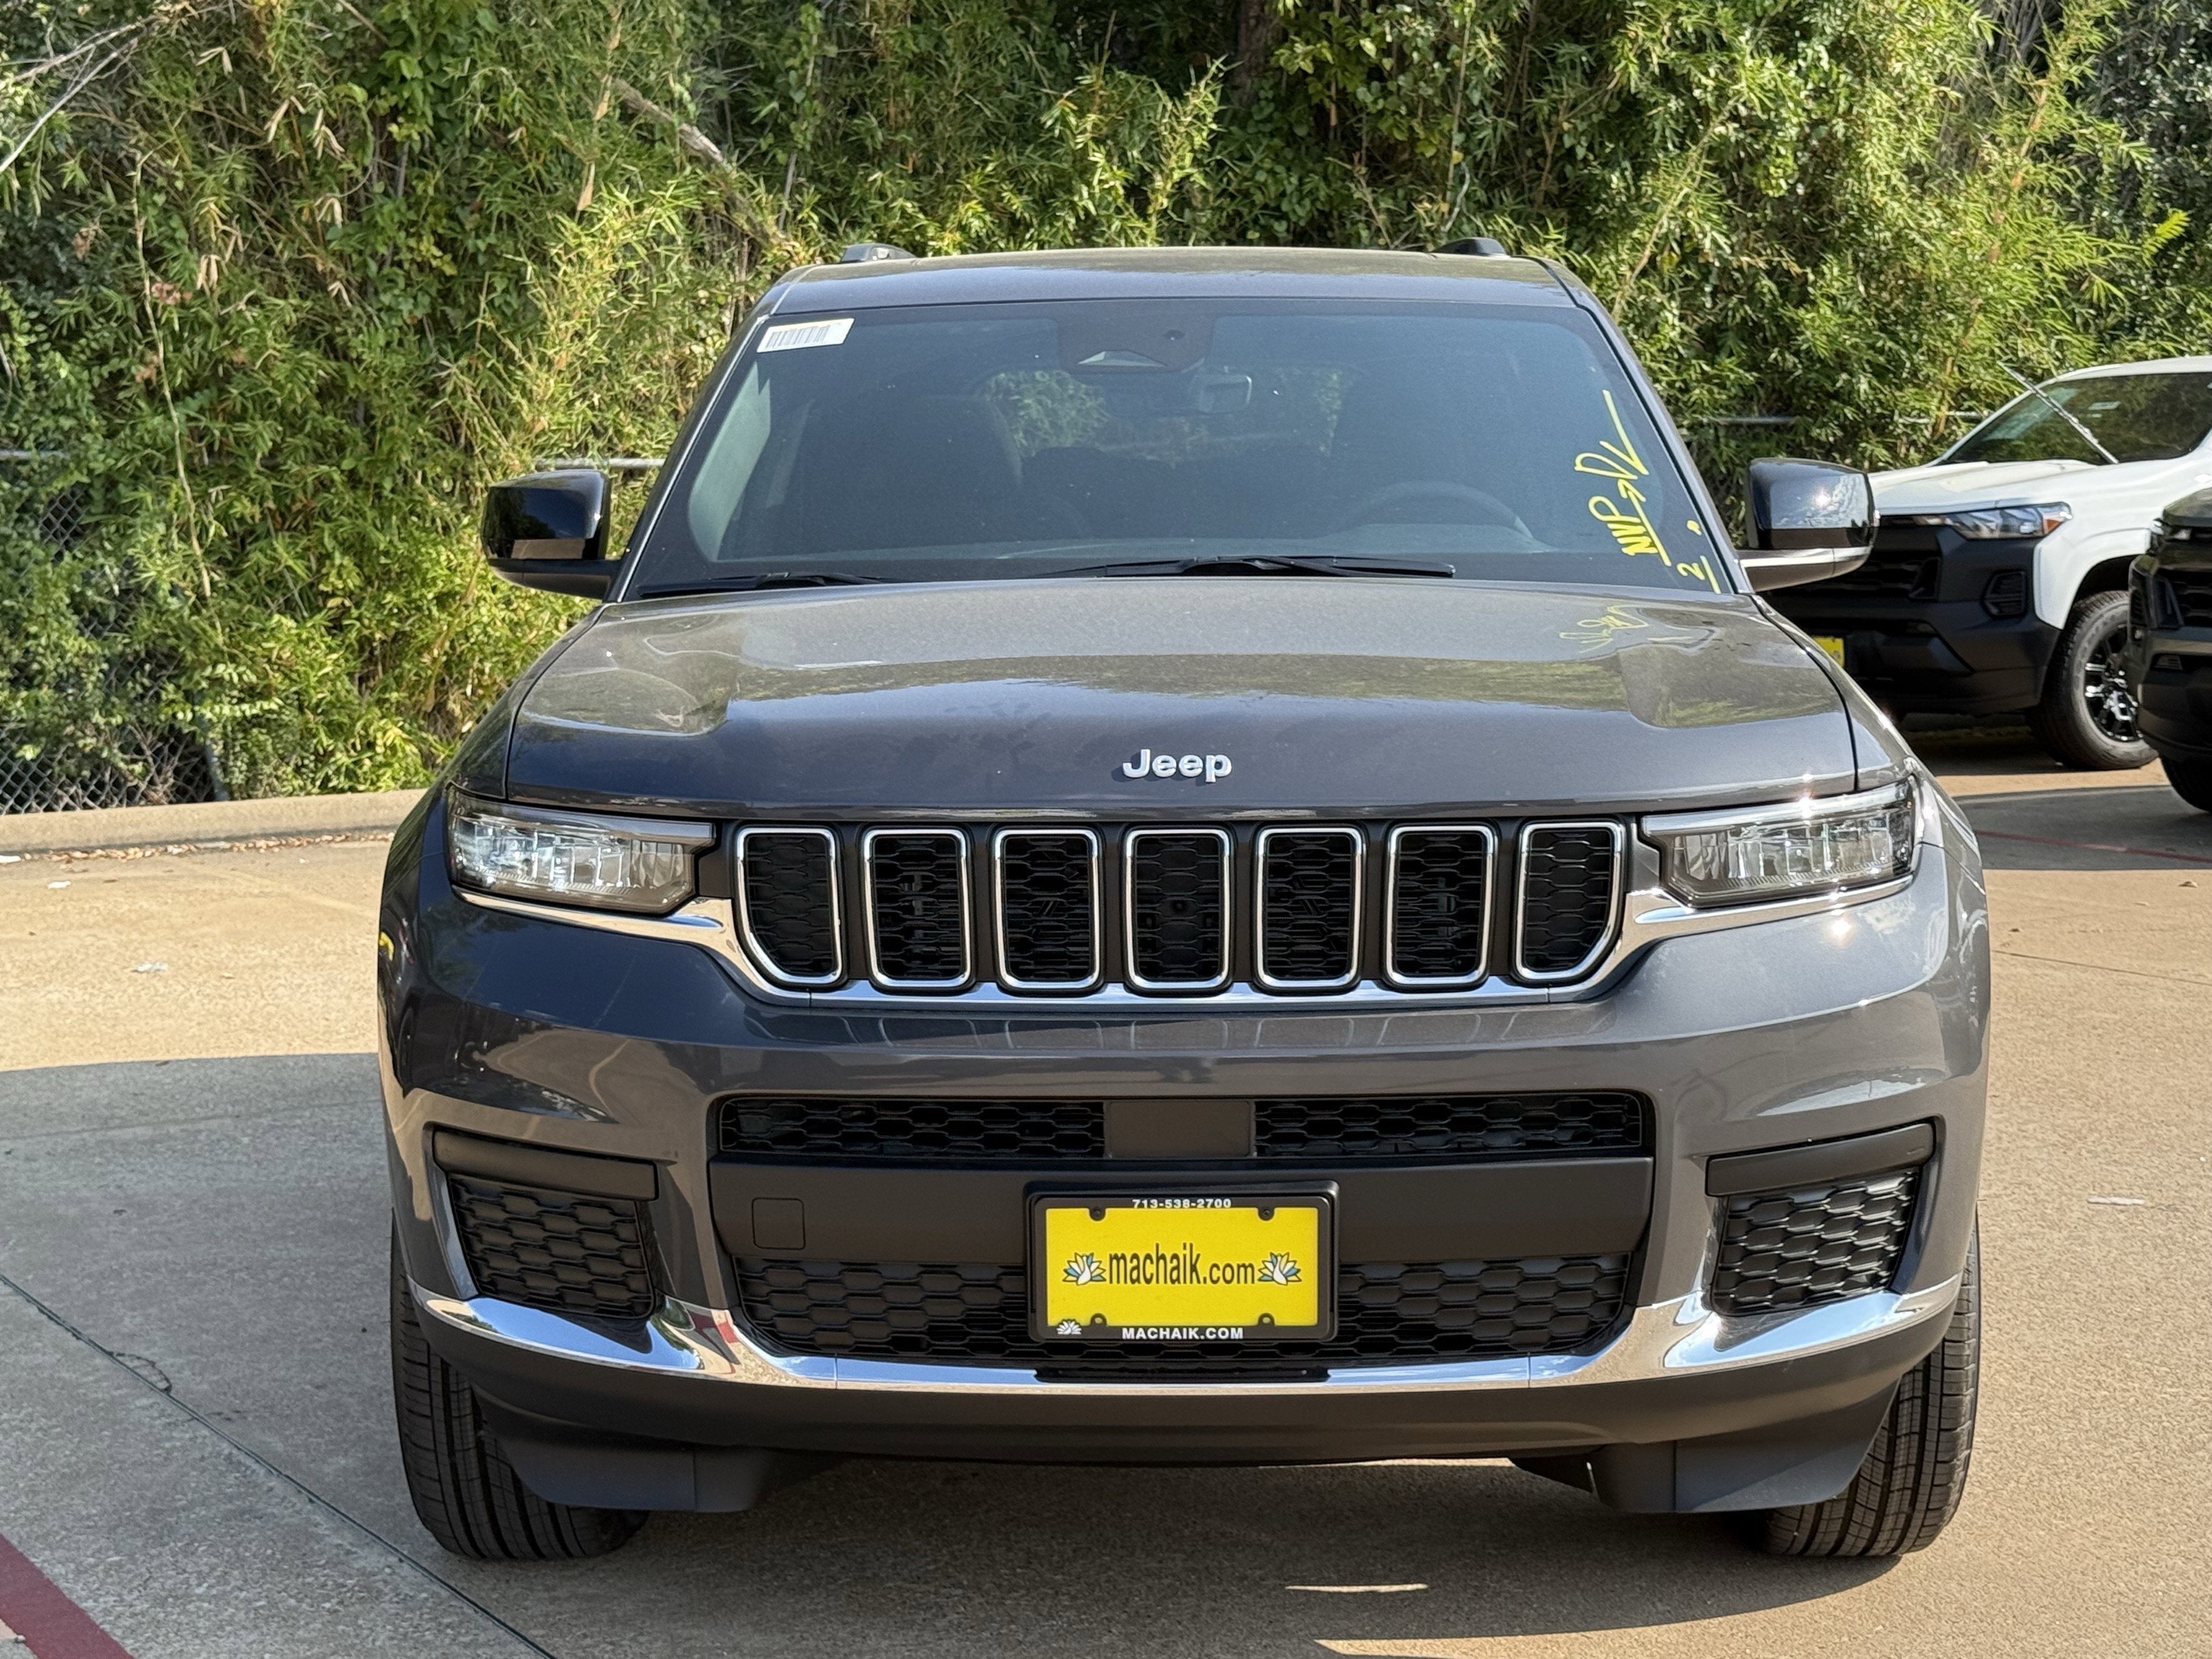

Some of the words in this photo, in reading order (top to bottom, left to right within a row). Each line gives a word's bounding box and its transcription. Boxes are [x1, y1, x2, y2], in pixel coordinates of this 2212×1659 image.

[1122, 749, 1232, 782] Jeep
[1132, 1199, 1232, 1209] 713-538-2700
[1108, 1242, 1256, 1285] machaik.com
[1122, 1327, 1244, 1340] MACHAIK.COM
